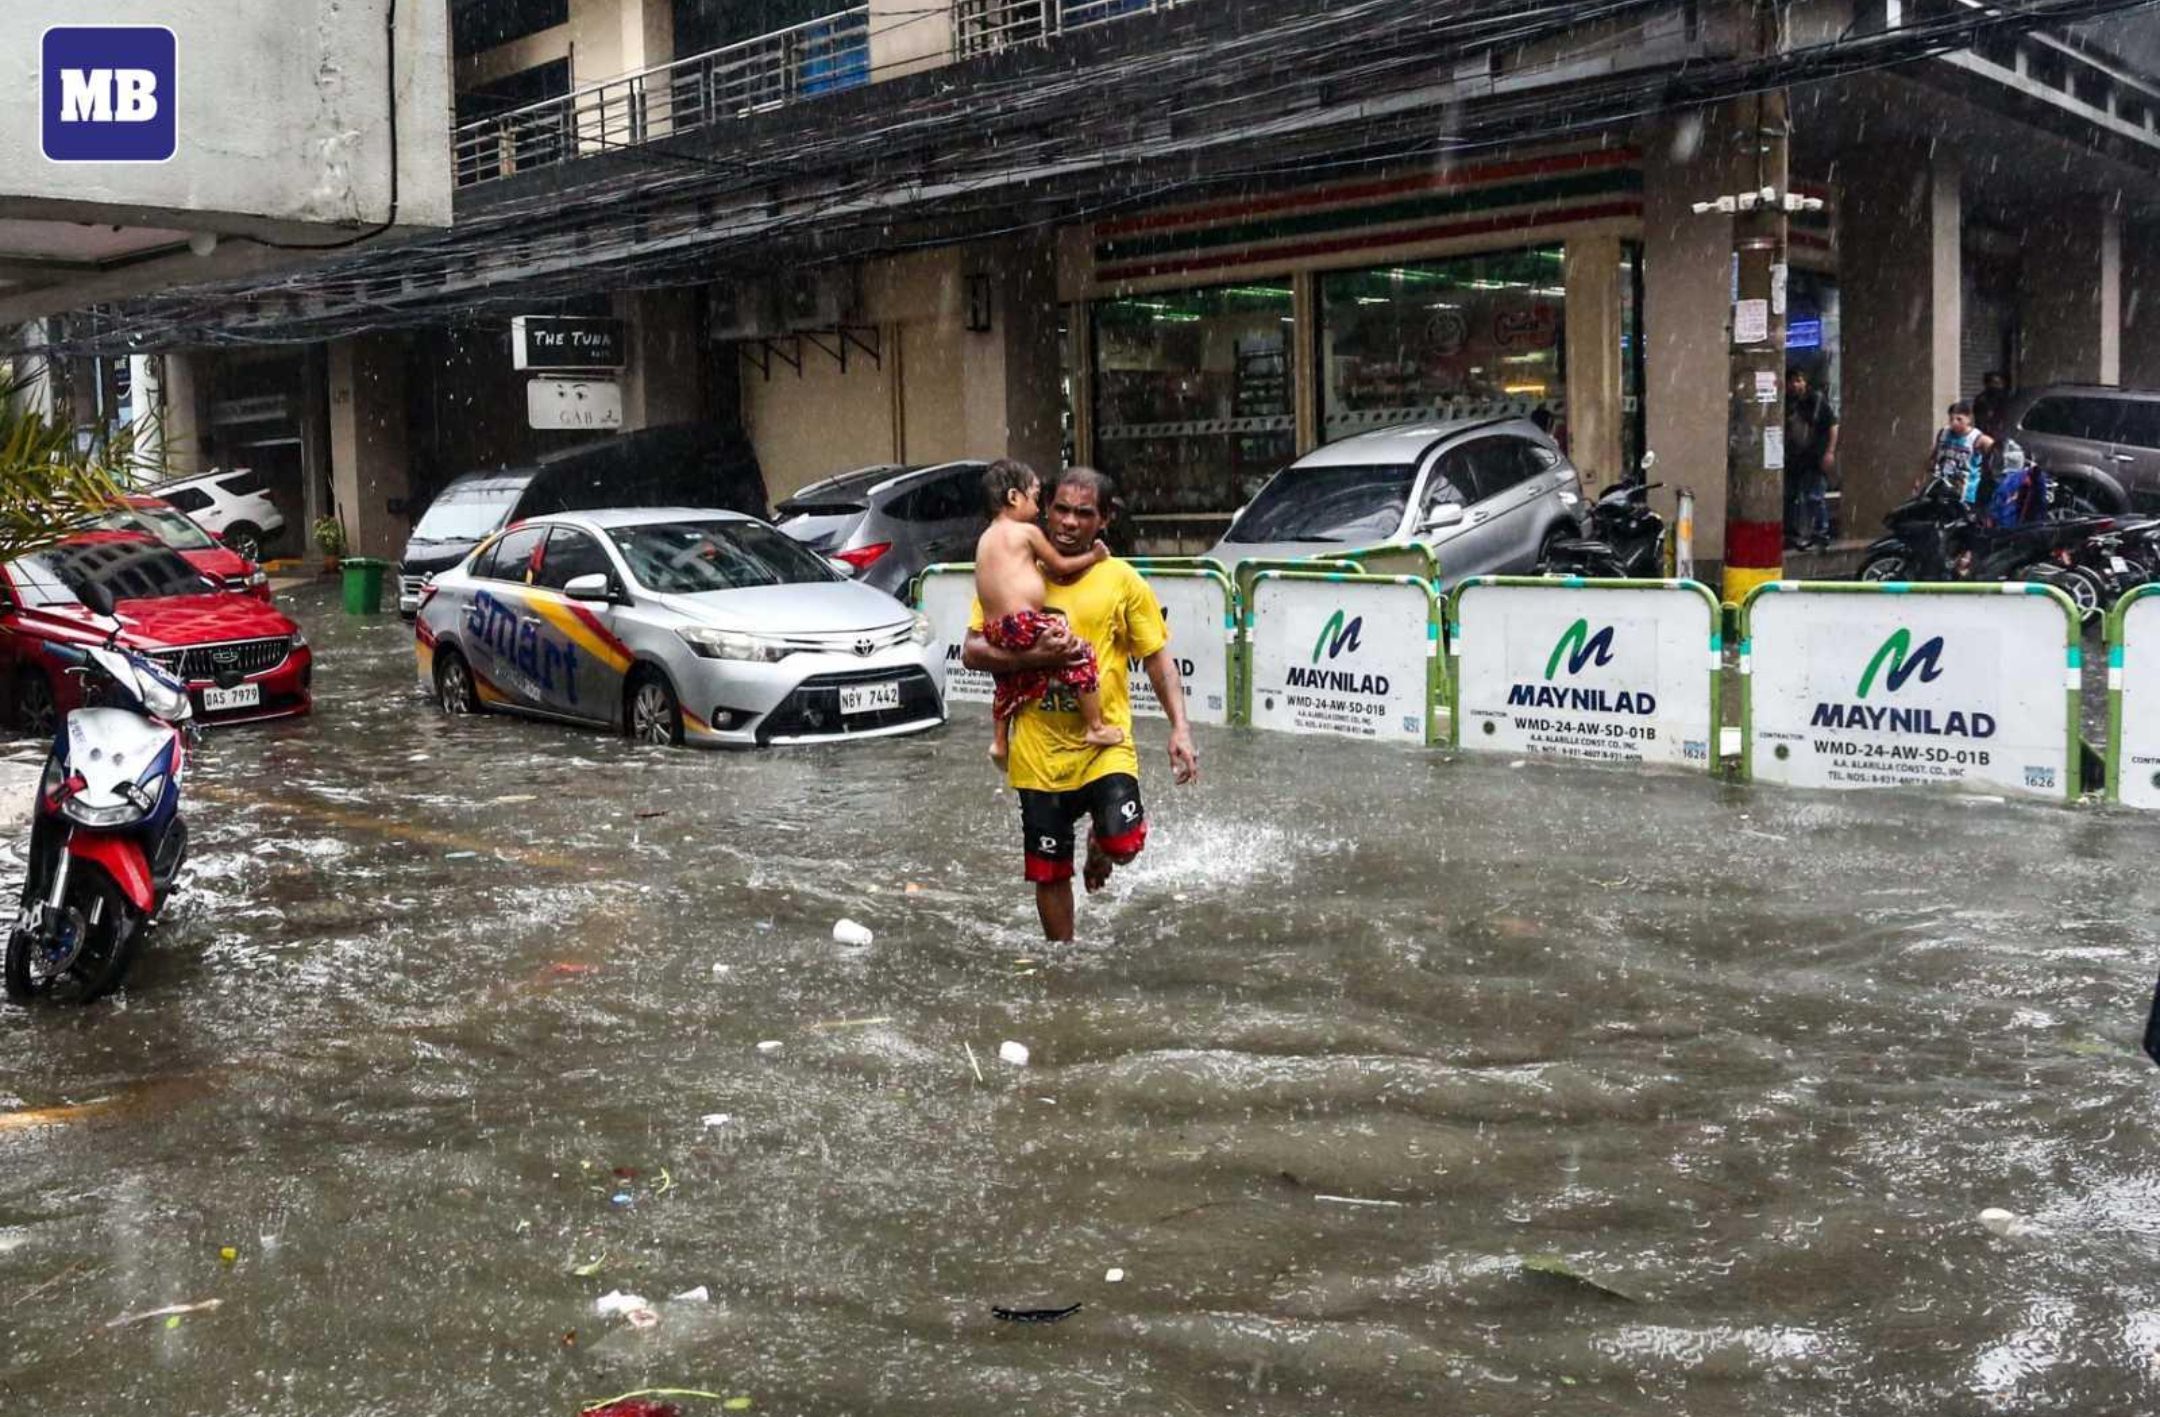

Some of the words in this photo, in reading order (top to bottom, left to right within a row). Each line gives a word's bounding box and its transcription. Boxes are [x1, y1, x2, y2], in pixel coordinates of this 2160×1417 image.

[468, 590, 578, 704] smart
[1286, 667, 1389, 695] MAYNILAD
[869, 688, 897, 705] 7442
[1286, 695, 1387, 716] WMD-24-AW-SD-01B
[1507, 684, 1657, 715] MAYNILAD
[1515, 717, 1656, 741] WMD-24-AW-SD-01B
[1810, 703, 1997, 739] MAYNILAD
[1814, 740, 1990, 766] WMD-24-AW-SD-01B
[2025, 775, 2056, 788] 1626
